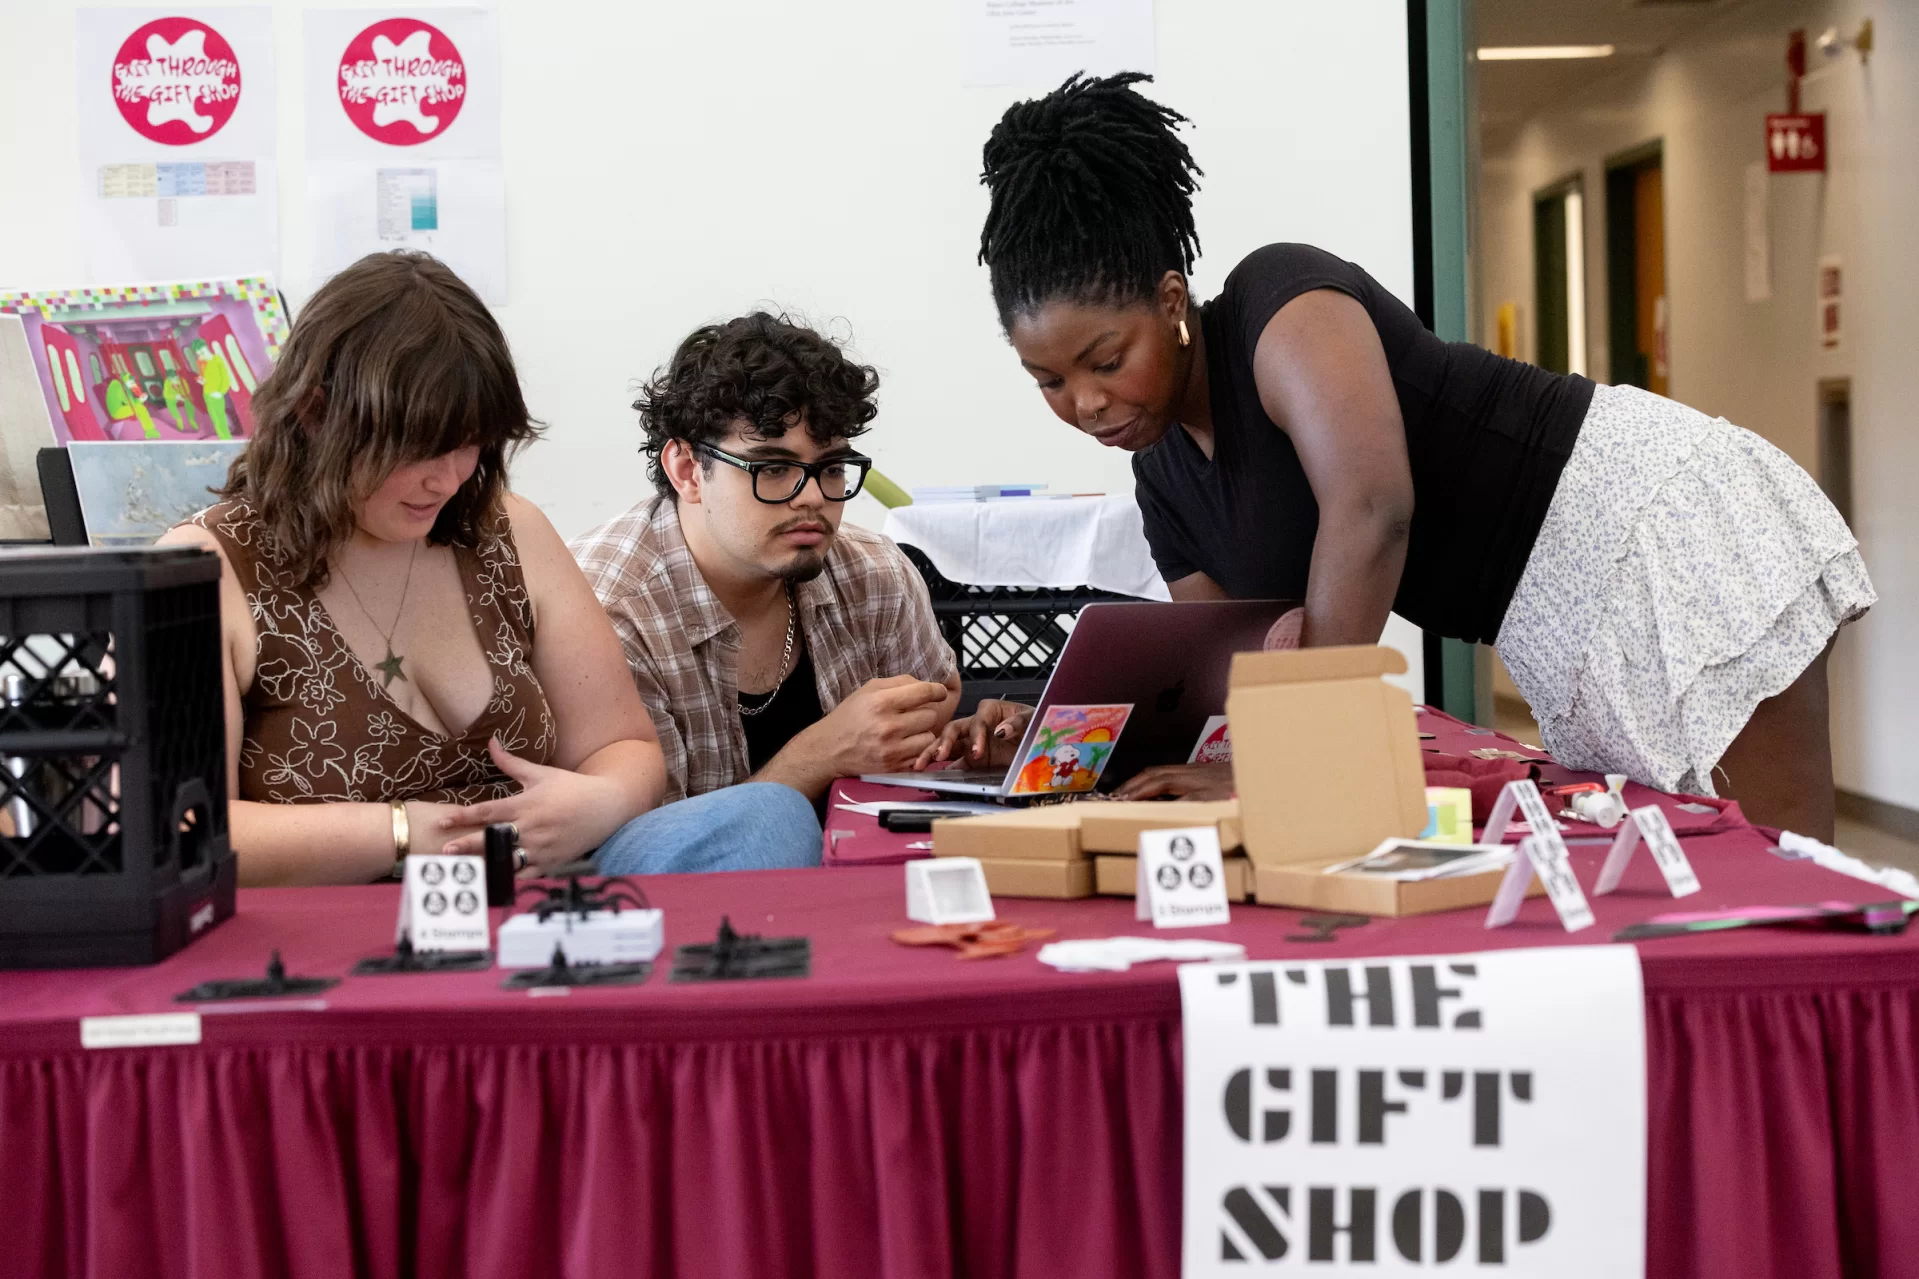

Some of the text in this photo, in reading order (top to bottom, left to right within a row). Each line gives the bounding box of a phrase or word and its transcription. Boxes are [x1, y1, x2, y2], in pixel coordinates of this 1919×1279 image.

[115, 55, 237, 79] EXIT THROUGH
[341, 56, 463, 79] EXIT THROUGH
[115, 83, 239, 105] THE GIFT SHOP
[341, 83, 465, 106] THE GIFT SHOP
[1217, 964, 1483, 1029] THE
[1222, 1066, 1533, 1147] GIFT
[1219, 1185, 1554, 1266] SHOP
